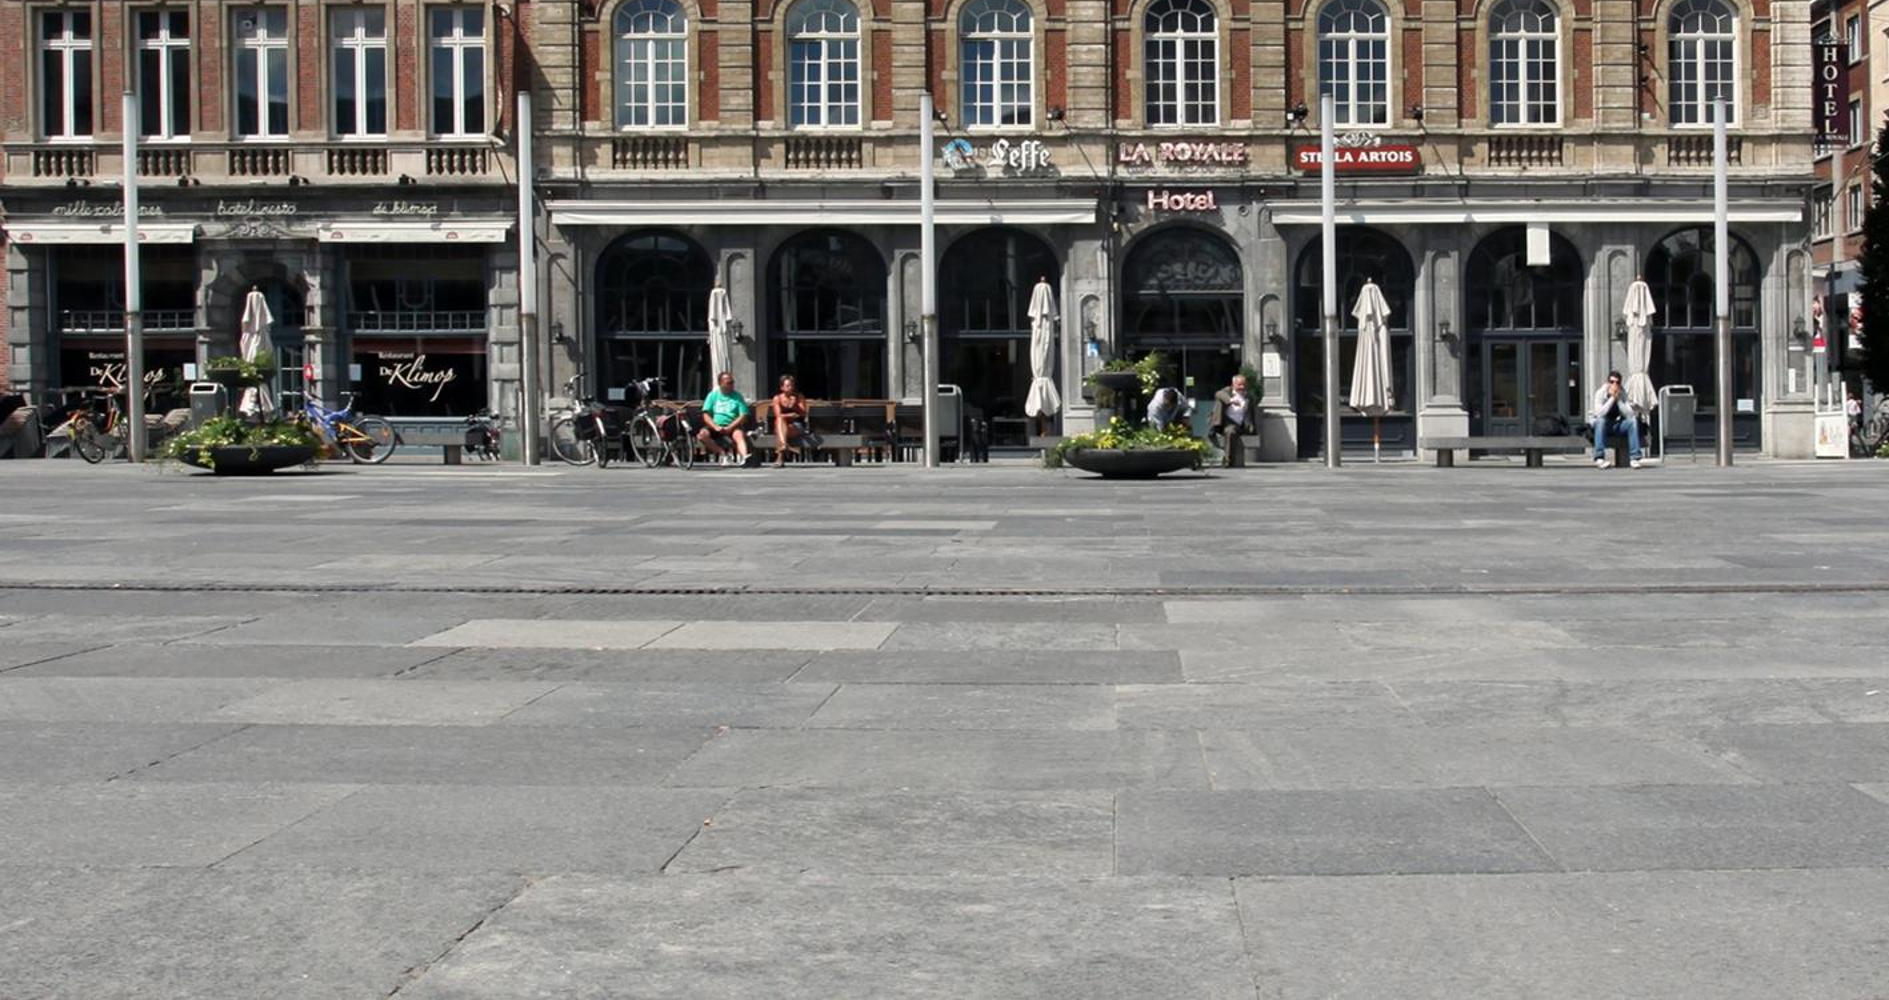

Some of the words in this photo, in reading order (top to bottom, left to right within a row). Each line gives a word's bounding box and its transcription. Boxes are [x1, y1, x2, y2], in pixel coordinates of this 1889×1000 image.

[1823, 46, 1838, 134] HOTEL
[987, 138, 1050, 172] Leffe
[1119, 142, 1150, 161] LA
[1159, 142, 1244, 161] ROYALE
[1300, 151, 1353, 163] STELA
[1358, 151, 1413, 162] ARTOIS
[1147, 190, 1217, 211] Hotel
[99, 363, 167, 400] Klop
[380, 366, 392, 376] De
[388, 354, 457, 402] Klimop
